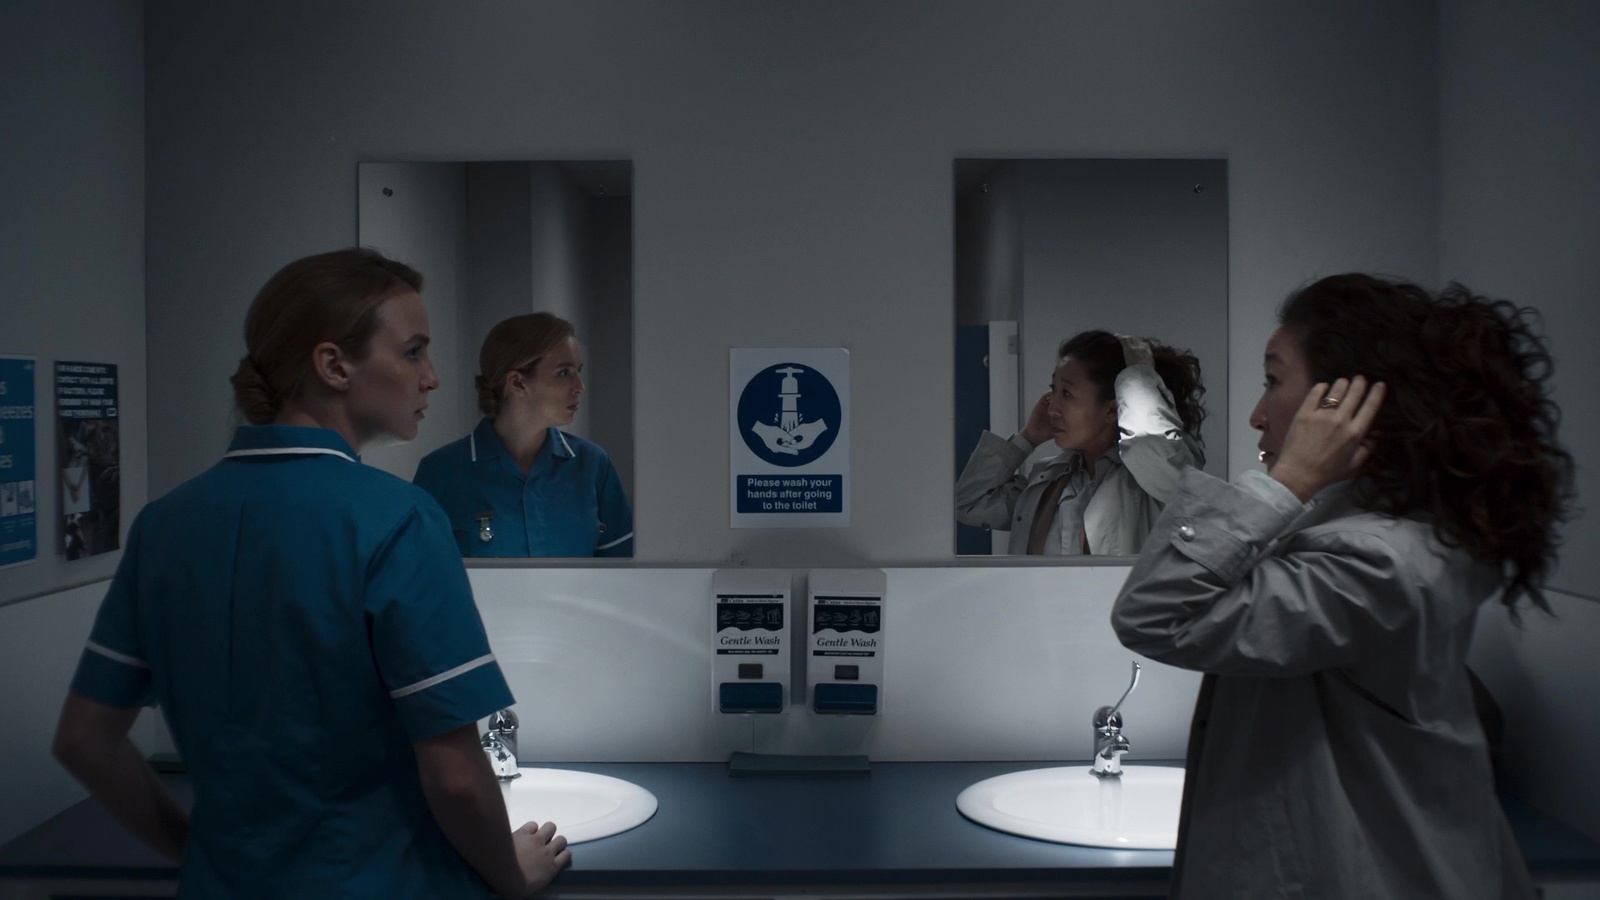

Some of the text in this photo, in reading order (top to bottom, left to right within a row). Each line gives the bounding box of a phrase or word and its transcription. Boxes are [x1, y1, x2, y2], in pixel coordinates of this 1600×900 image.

[747, 478, 833, 489] Please wash your
[747, 489, 832, 500] hands after going
[762, 501, 817, 510] to the toilet
[720, 636, 780, 645] Gentle Wash
[816, 637, 877, 648] Gentle Wash
